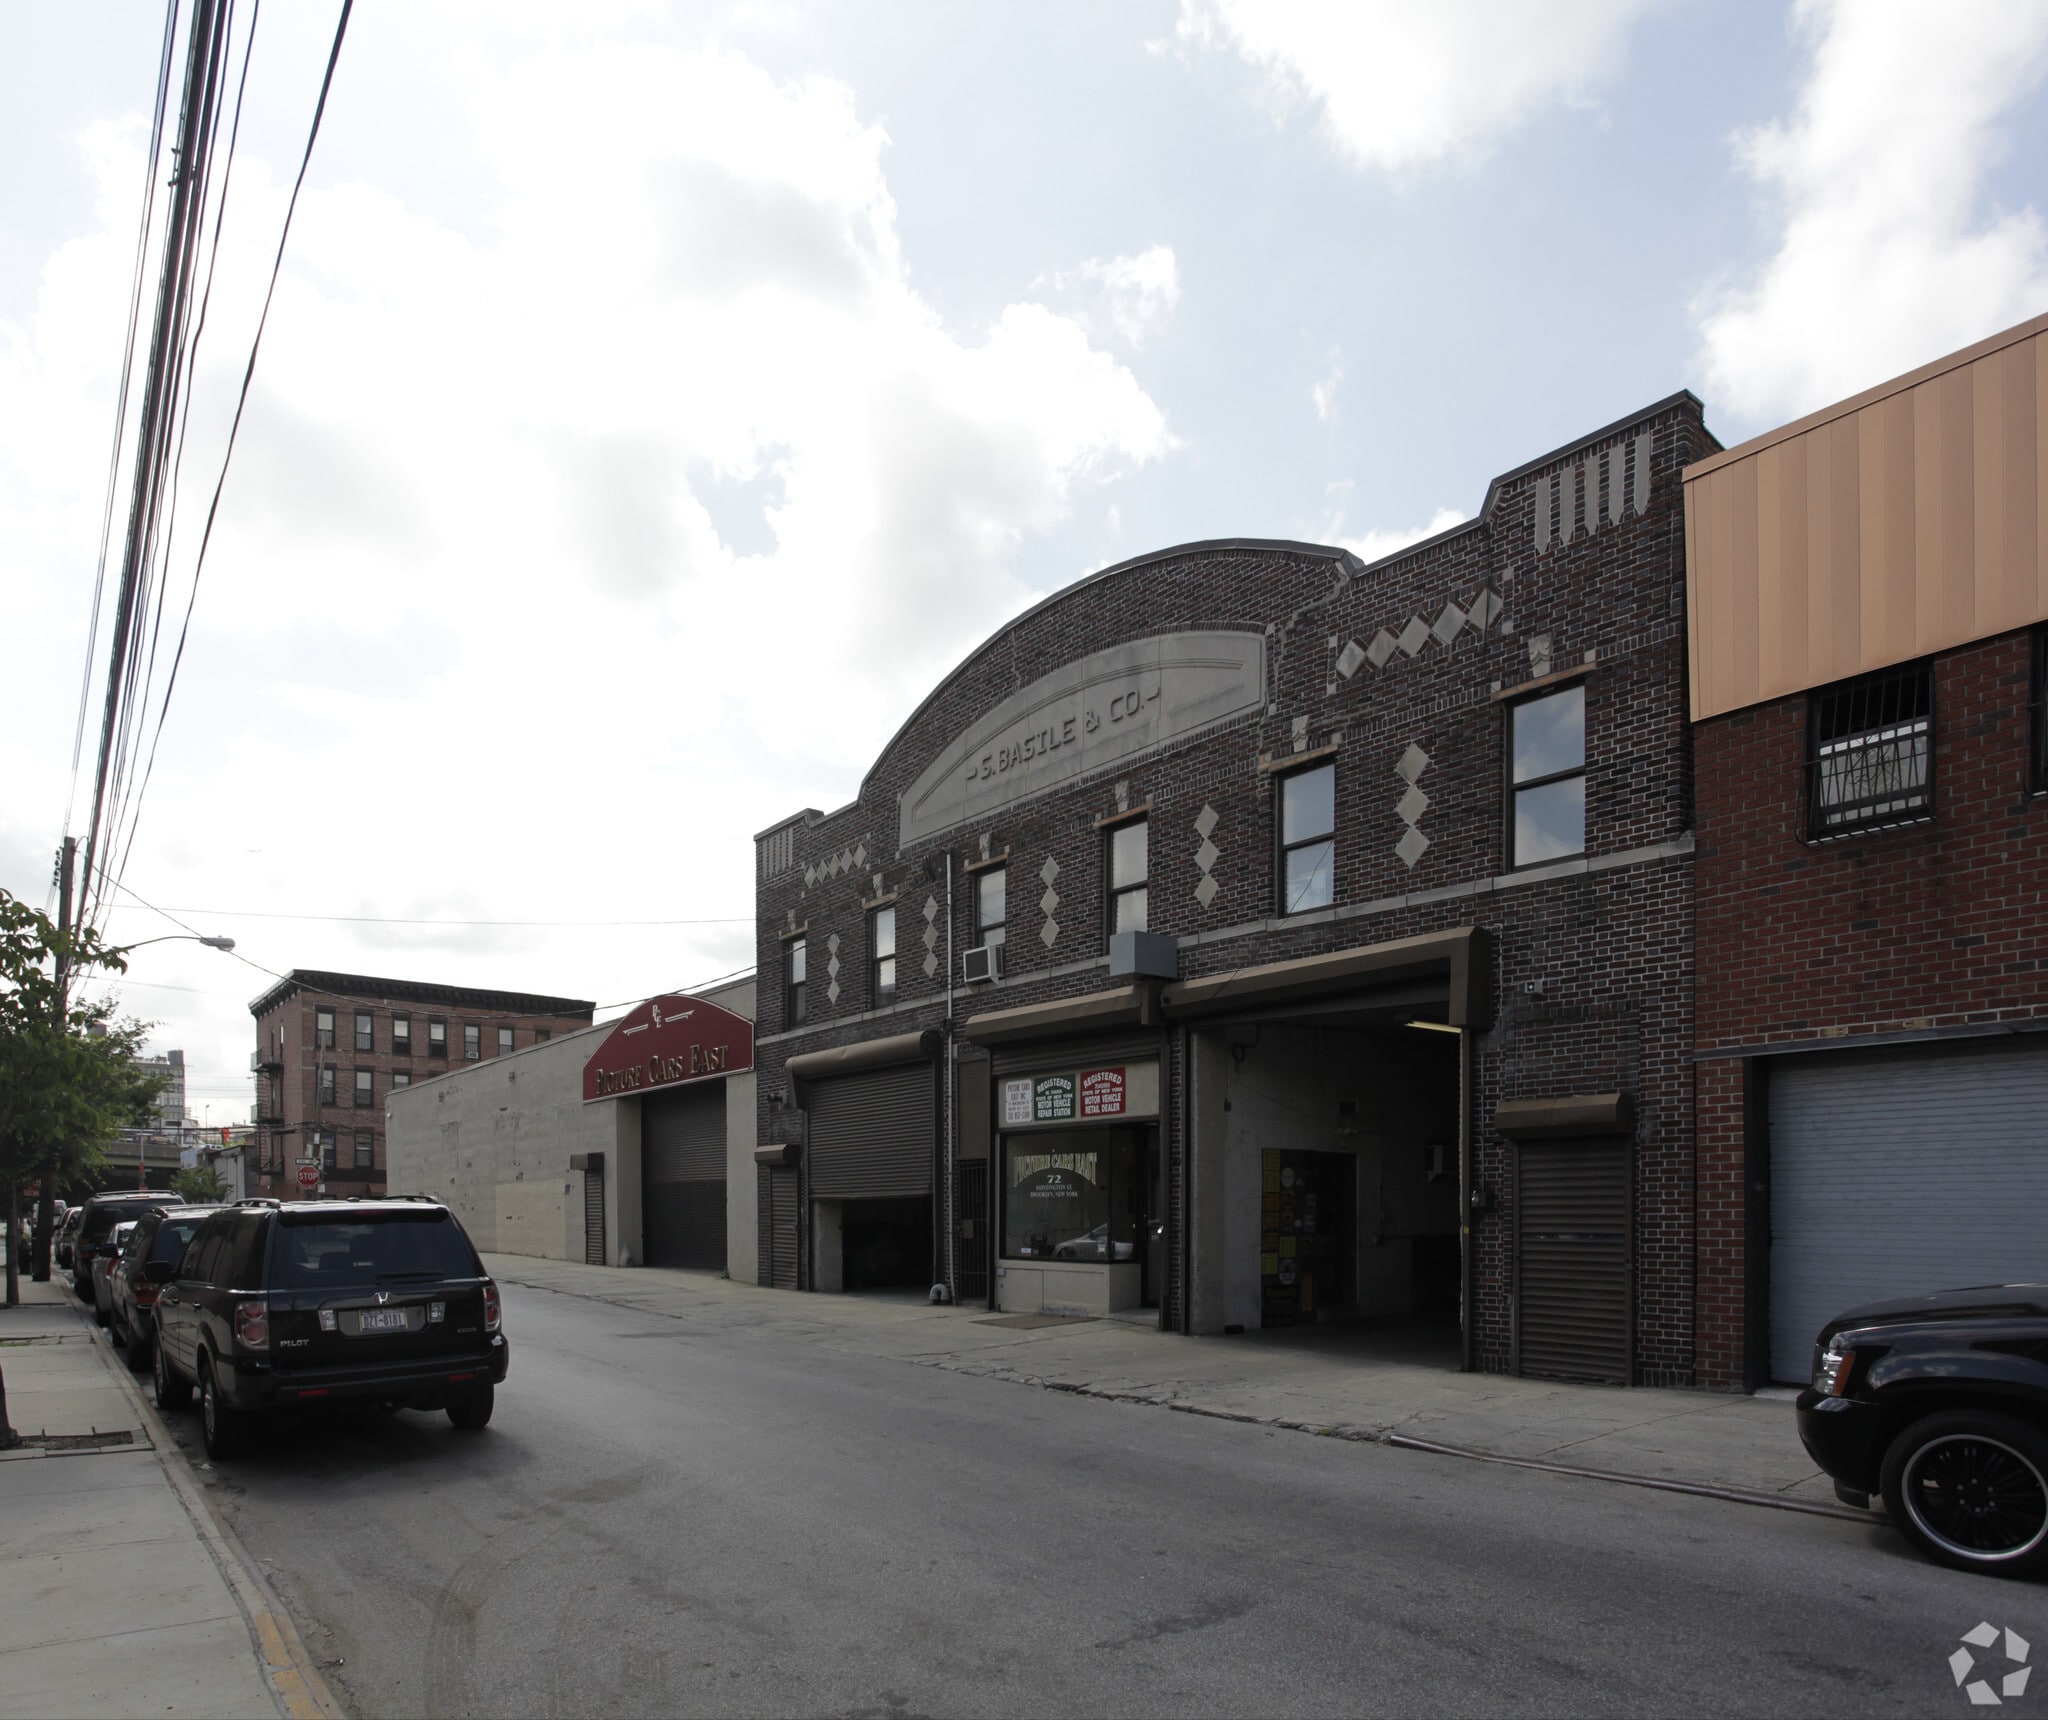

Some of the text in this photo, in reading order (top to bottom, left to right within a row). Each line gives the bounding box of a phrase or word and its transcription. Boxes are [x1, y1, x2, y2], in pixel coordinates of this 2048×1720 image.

[1085, 710, 1100, 734] &
[596, 1044, 728, 1094] PICTURE CARS EAST
[1036, 1078, 1072, 1094] REGISTERED
[1083, 1071, 1122, 1089] REGISTERED
[1037, 1100, 1052, 1109] MOTOR
[1053, 1098, 1071, 1108] VEHICLE
[1085, 1093, 1121, 1105] MOTOR VEHICLE
[1037, 1107, 1071, 1118] REPAIR STATION
[1085, 1102, 1120, 1114] RETAIL DEALER
[1013, 1151, 1098, 1188] PICTURE CARS EAST
[298, 1172, 318, 1181] STOP
[1047, 1174, 1062, 1184] 72
[280, 1338, 310, 1348] PILOT
